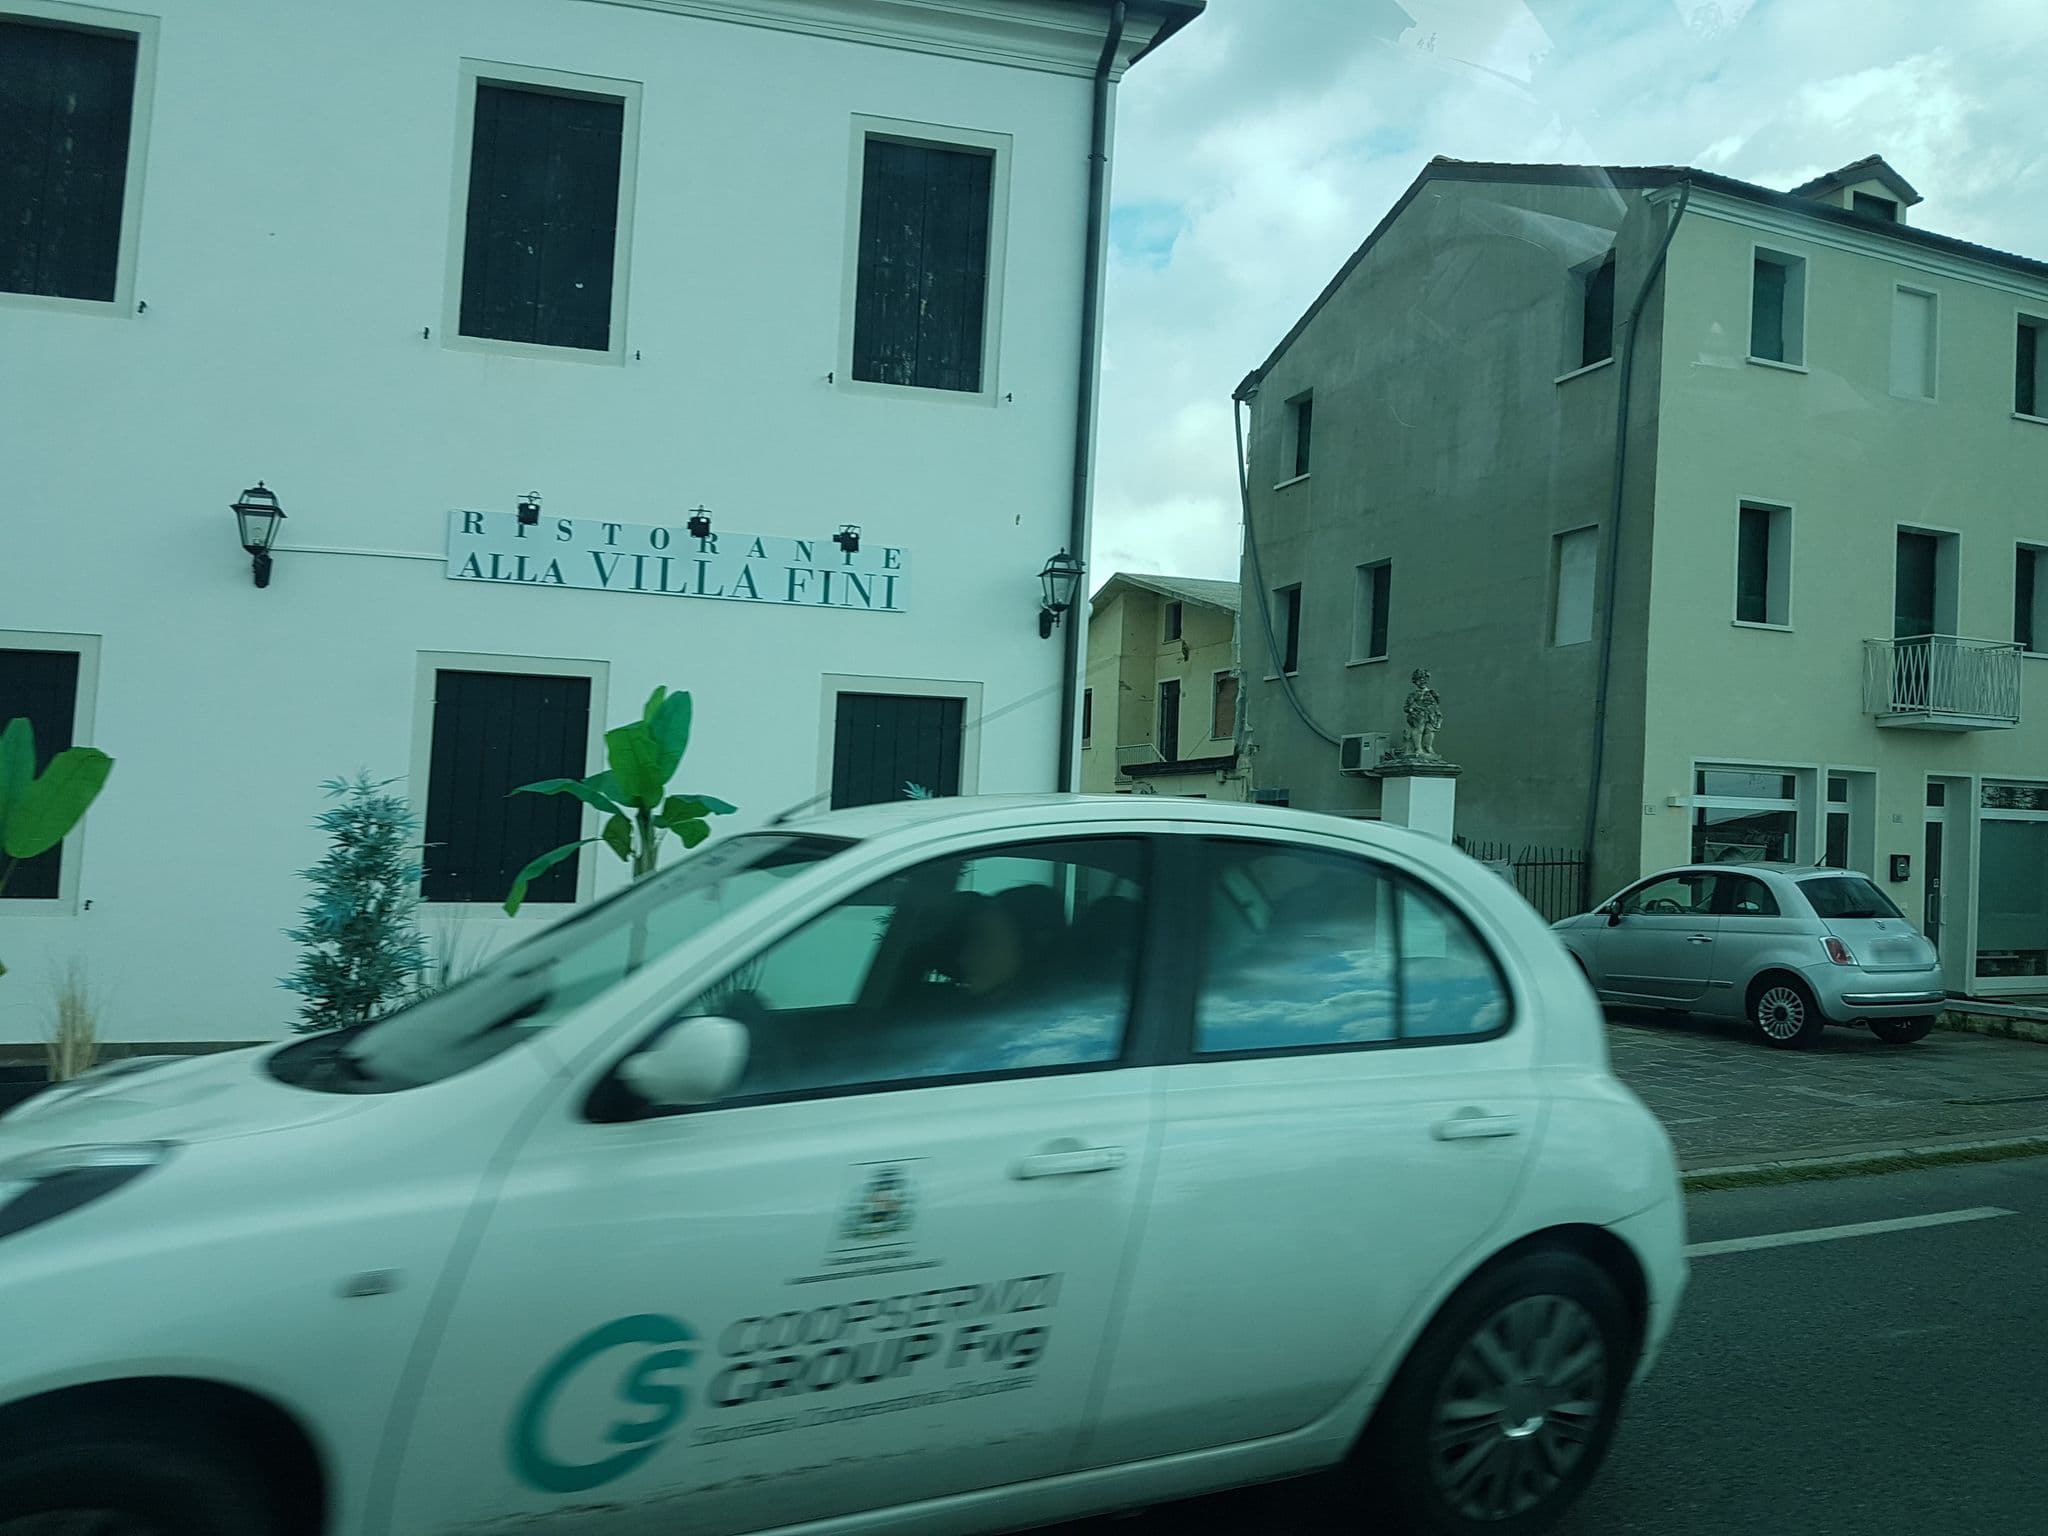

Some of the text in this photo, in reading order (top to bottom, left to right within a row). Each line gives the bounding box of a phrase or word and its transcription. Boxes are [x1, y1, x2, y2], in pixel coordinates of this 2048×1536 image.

[456, 550, 900, 609] ALLA VILLA FINI
